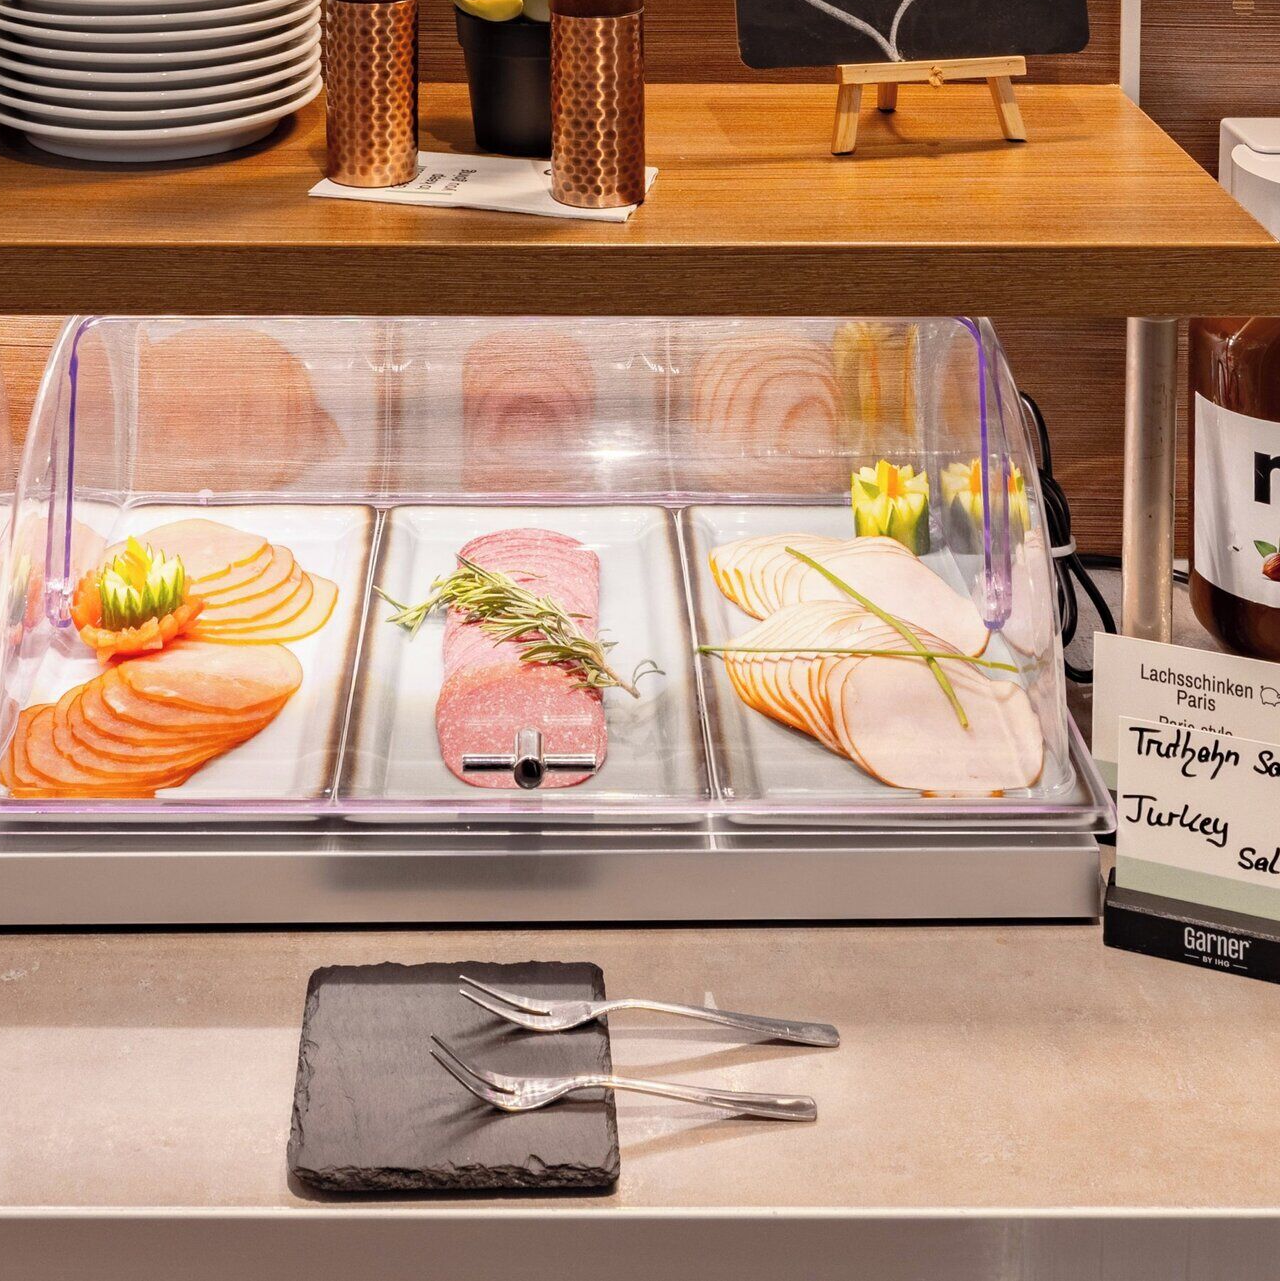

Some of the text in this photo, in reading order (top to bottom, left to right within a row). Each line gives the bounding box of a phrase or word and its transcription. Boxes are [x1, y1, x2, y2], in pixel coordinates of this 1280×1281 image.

[1141, 664, 1253, 699] Lachsschinken
[1177, 690, 1216, 712] Paris
[1122, 793, 1230, 849] Turkey
[1184, 926, 1250, 961] Garner
[1215, 959, 1230, 968] IHG
